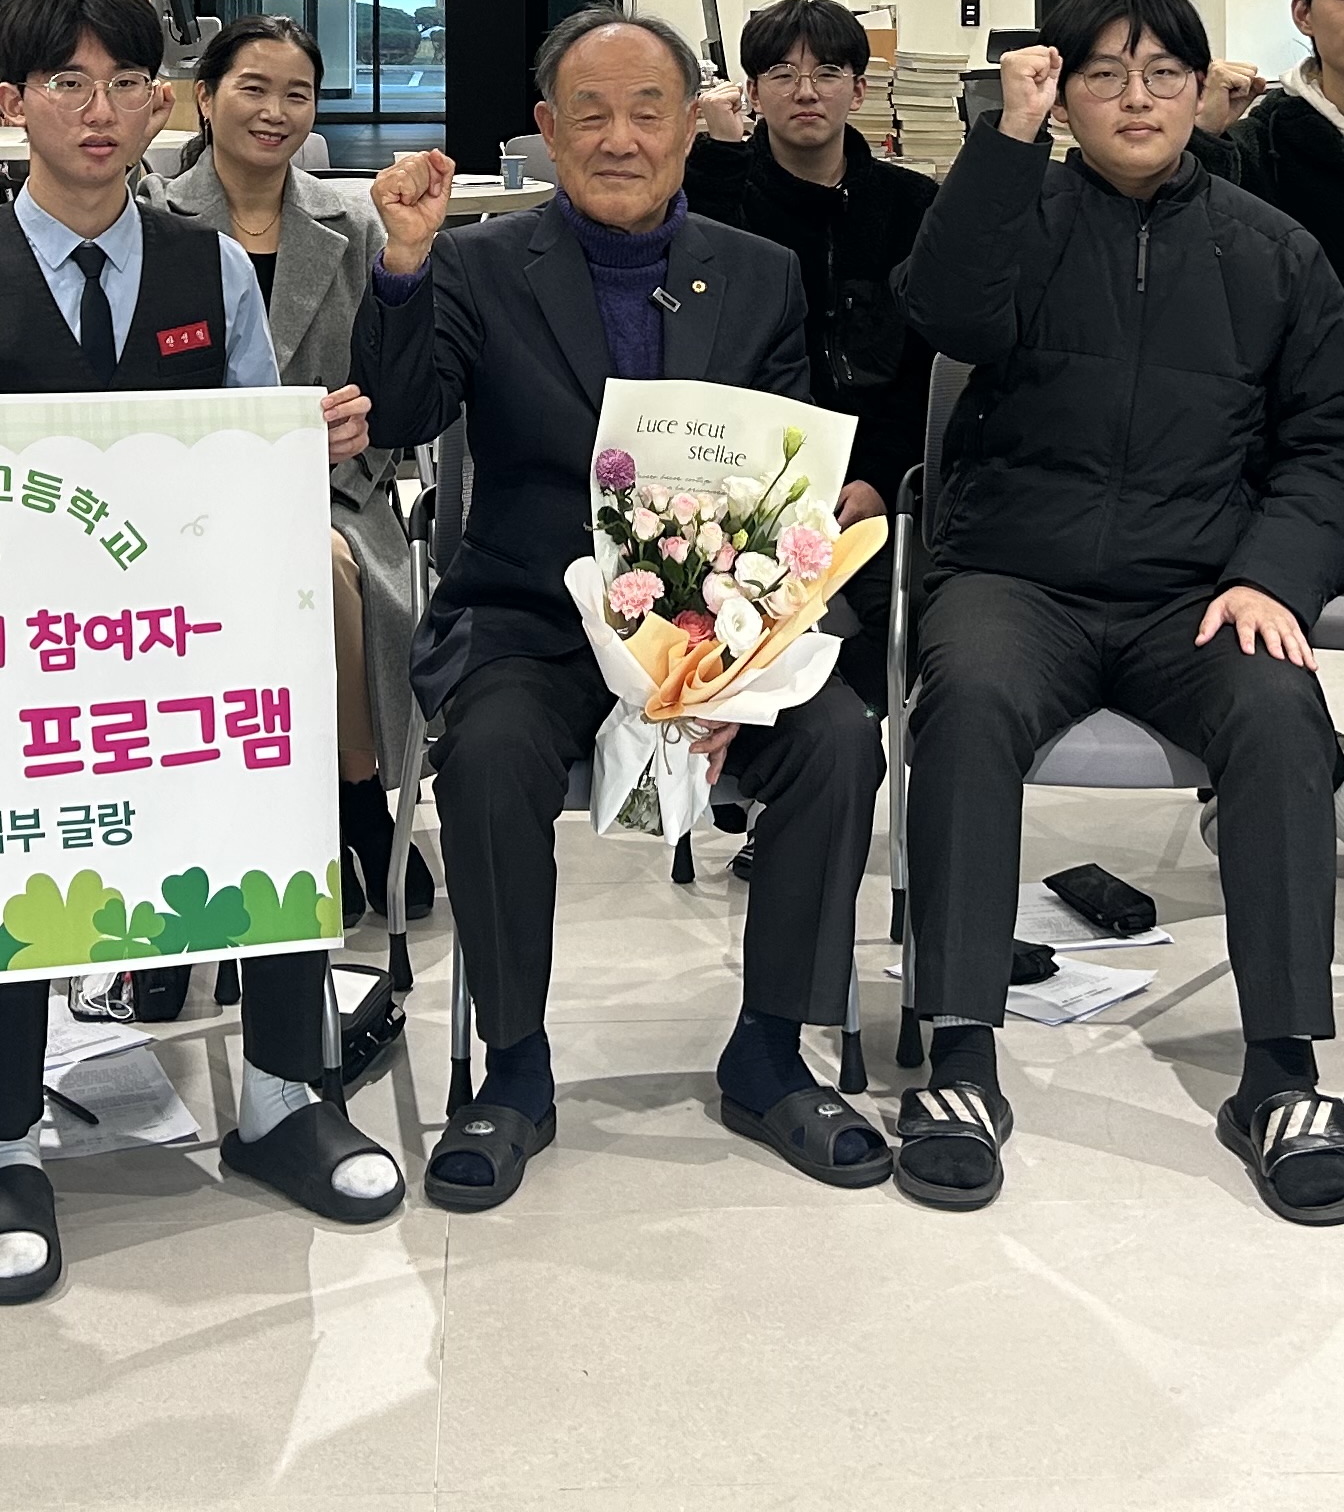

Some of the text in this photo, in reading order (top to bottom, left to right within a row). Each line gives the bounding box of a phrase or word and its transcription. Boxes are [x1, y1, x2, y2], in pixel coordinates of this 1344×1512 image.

[636, 414, 726, 440] Luce sicut
[687, 443, 747, 467] stellae
[26, 604, 223, 673] 참여자-
[18, 686, 293, 779] 프로그램
[56, 800, 136, 849] 글랑
